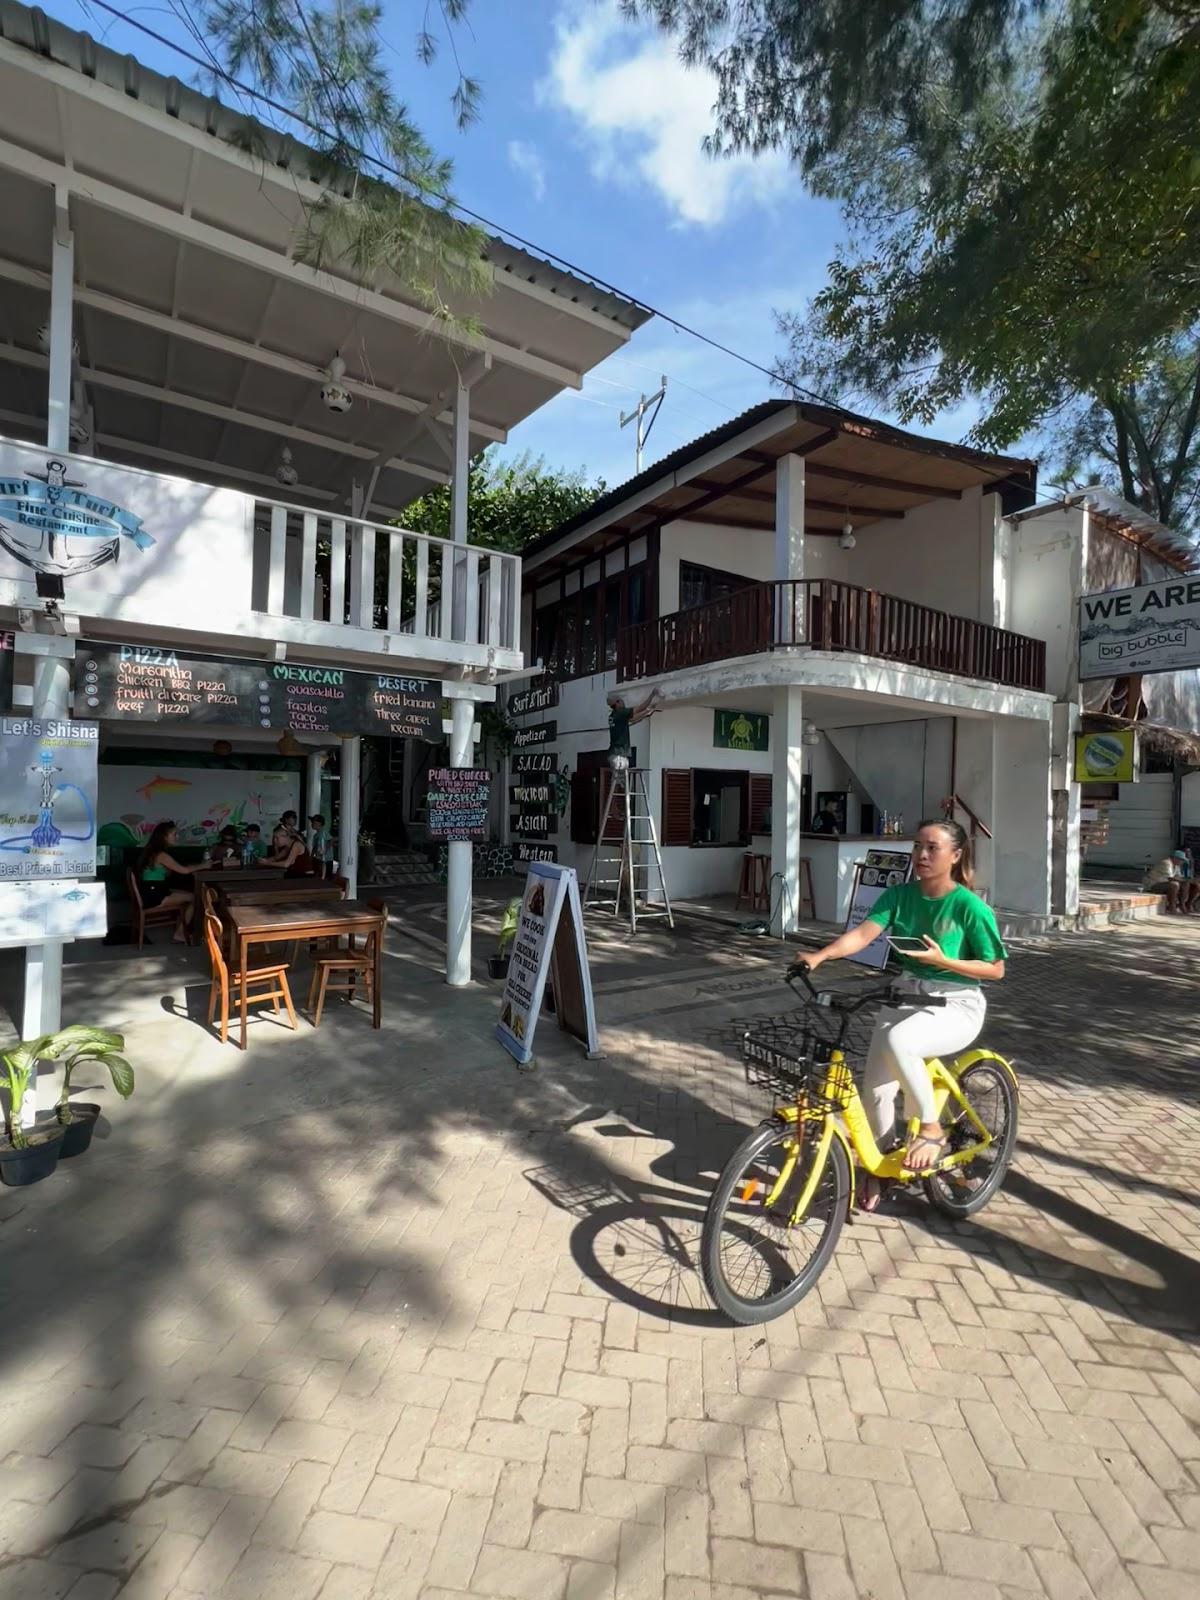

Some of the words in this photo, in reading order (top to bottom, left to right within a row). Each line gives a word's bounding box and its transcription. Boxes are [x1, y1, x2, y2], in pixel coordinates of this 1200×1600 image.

[47, 486, 62, 504] &
[72, 491, 121, 519] Turf
[17, 501, 47, 516] Fine
[52, 507, 100, 526] Cuisine
[18, 513, 89, 535] Restaurant
[1084, 594, 1132, 621] WE
[1139, 581, 1200, 613] ARE
[120, 645, 179, 667] PIZZA
[1101, 644, 1123, 658] big
[171, 679, 191, 690] BBQ
[273, 665, 344, 685] MEXICAN
[377, 675, 430, 694] DESERT
[513, 693, 530, 713] Surf
[2, 718, 42, 737] Let's
[513, 729, 547, 747] Appetizer
[517, 755, 552, 771] SALAD
[515, 815, 547, 831] Asian
[0, 862, 22, 877] Best
[25, 861, 52, 876] Price
[53, 860, 63, 874] in
[64, 860, 95, 873] Island
